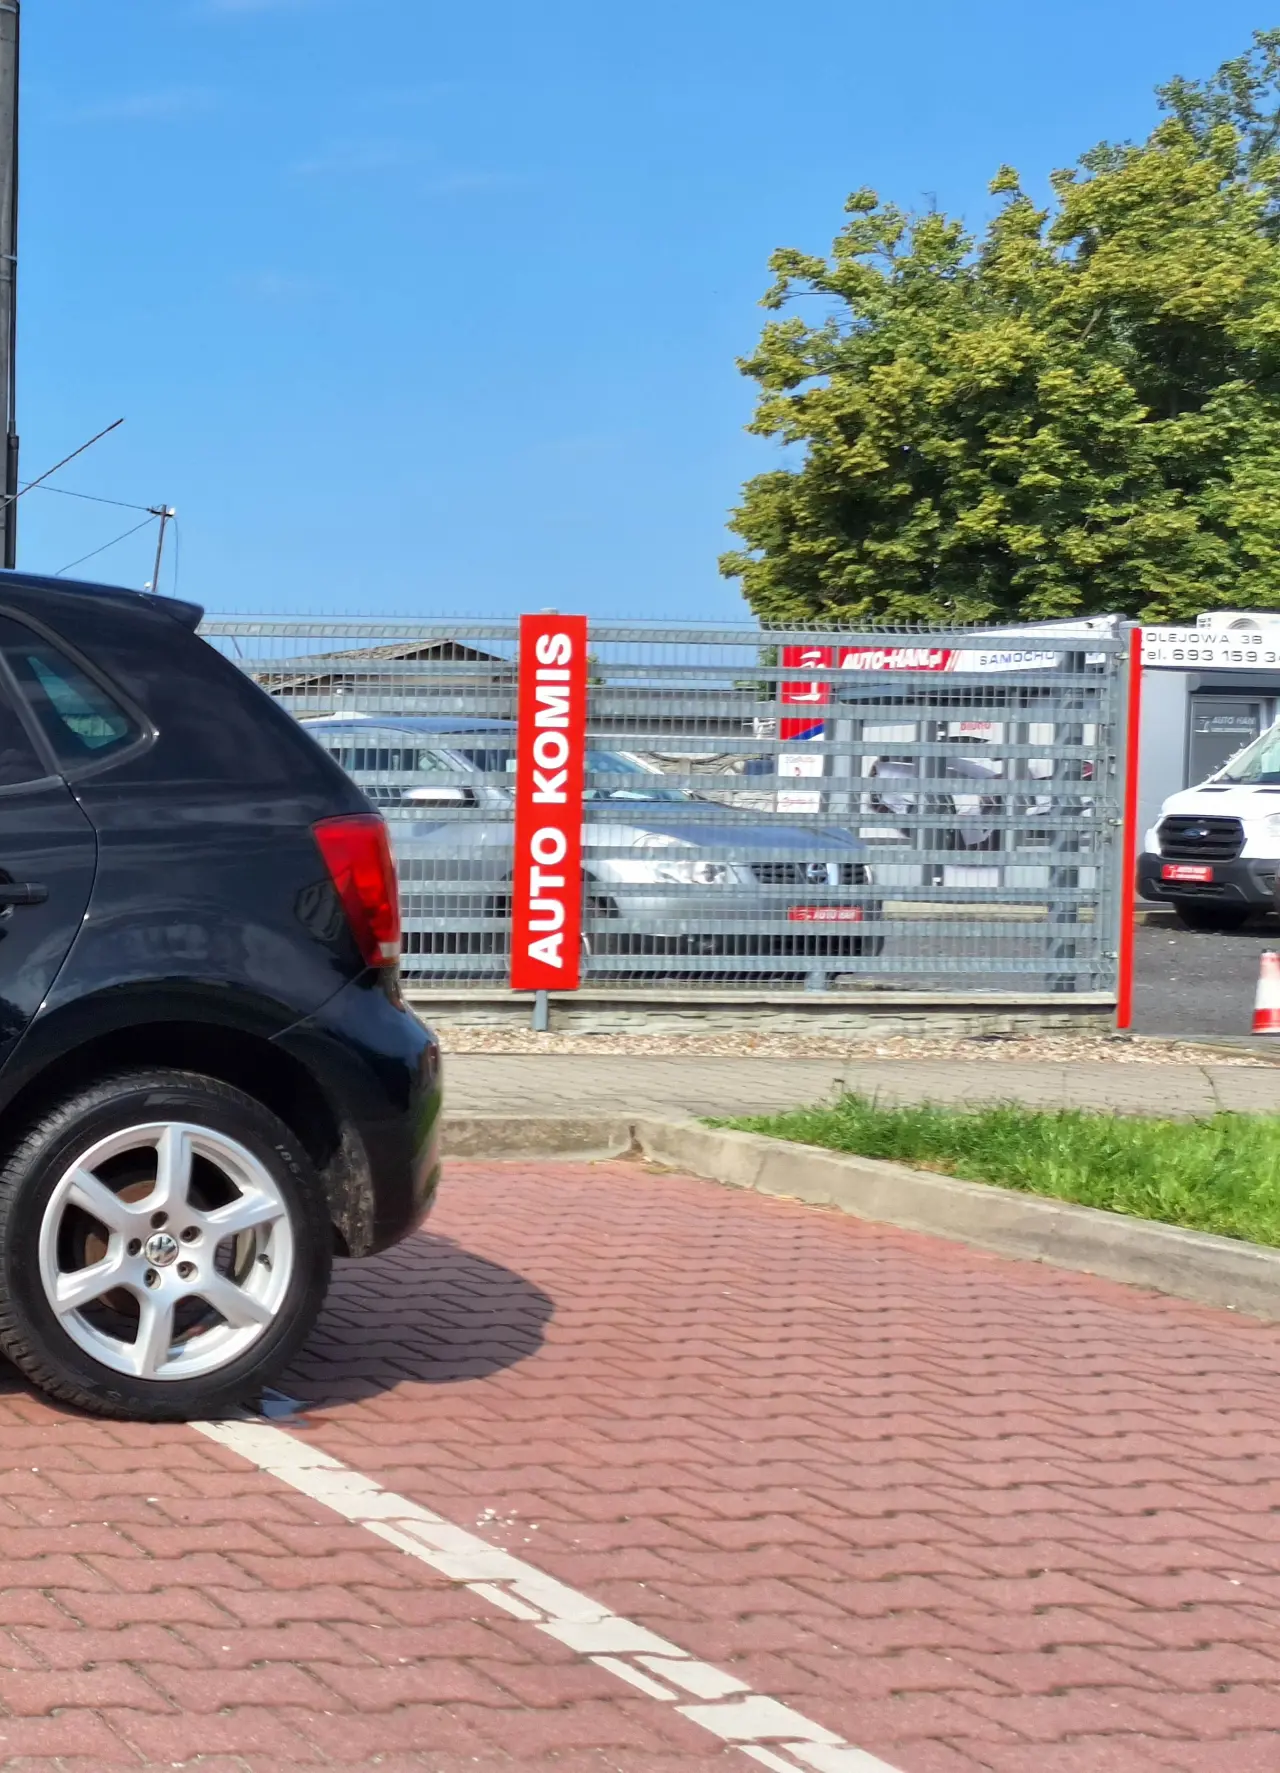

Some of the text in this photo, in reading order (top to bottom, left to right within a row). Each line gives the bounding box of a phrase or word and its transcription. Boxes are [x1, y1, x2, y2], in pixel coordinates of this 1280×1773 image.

[1141, 648, 1280, 663] el. 693 159 3
[528, 633, 572, 969] AUTO KOMIS
